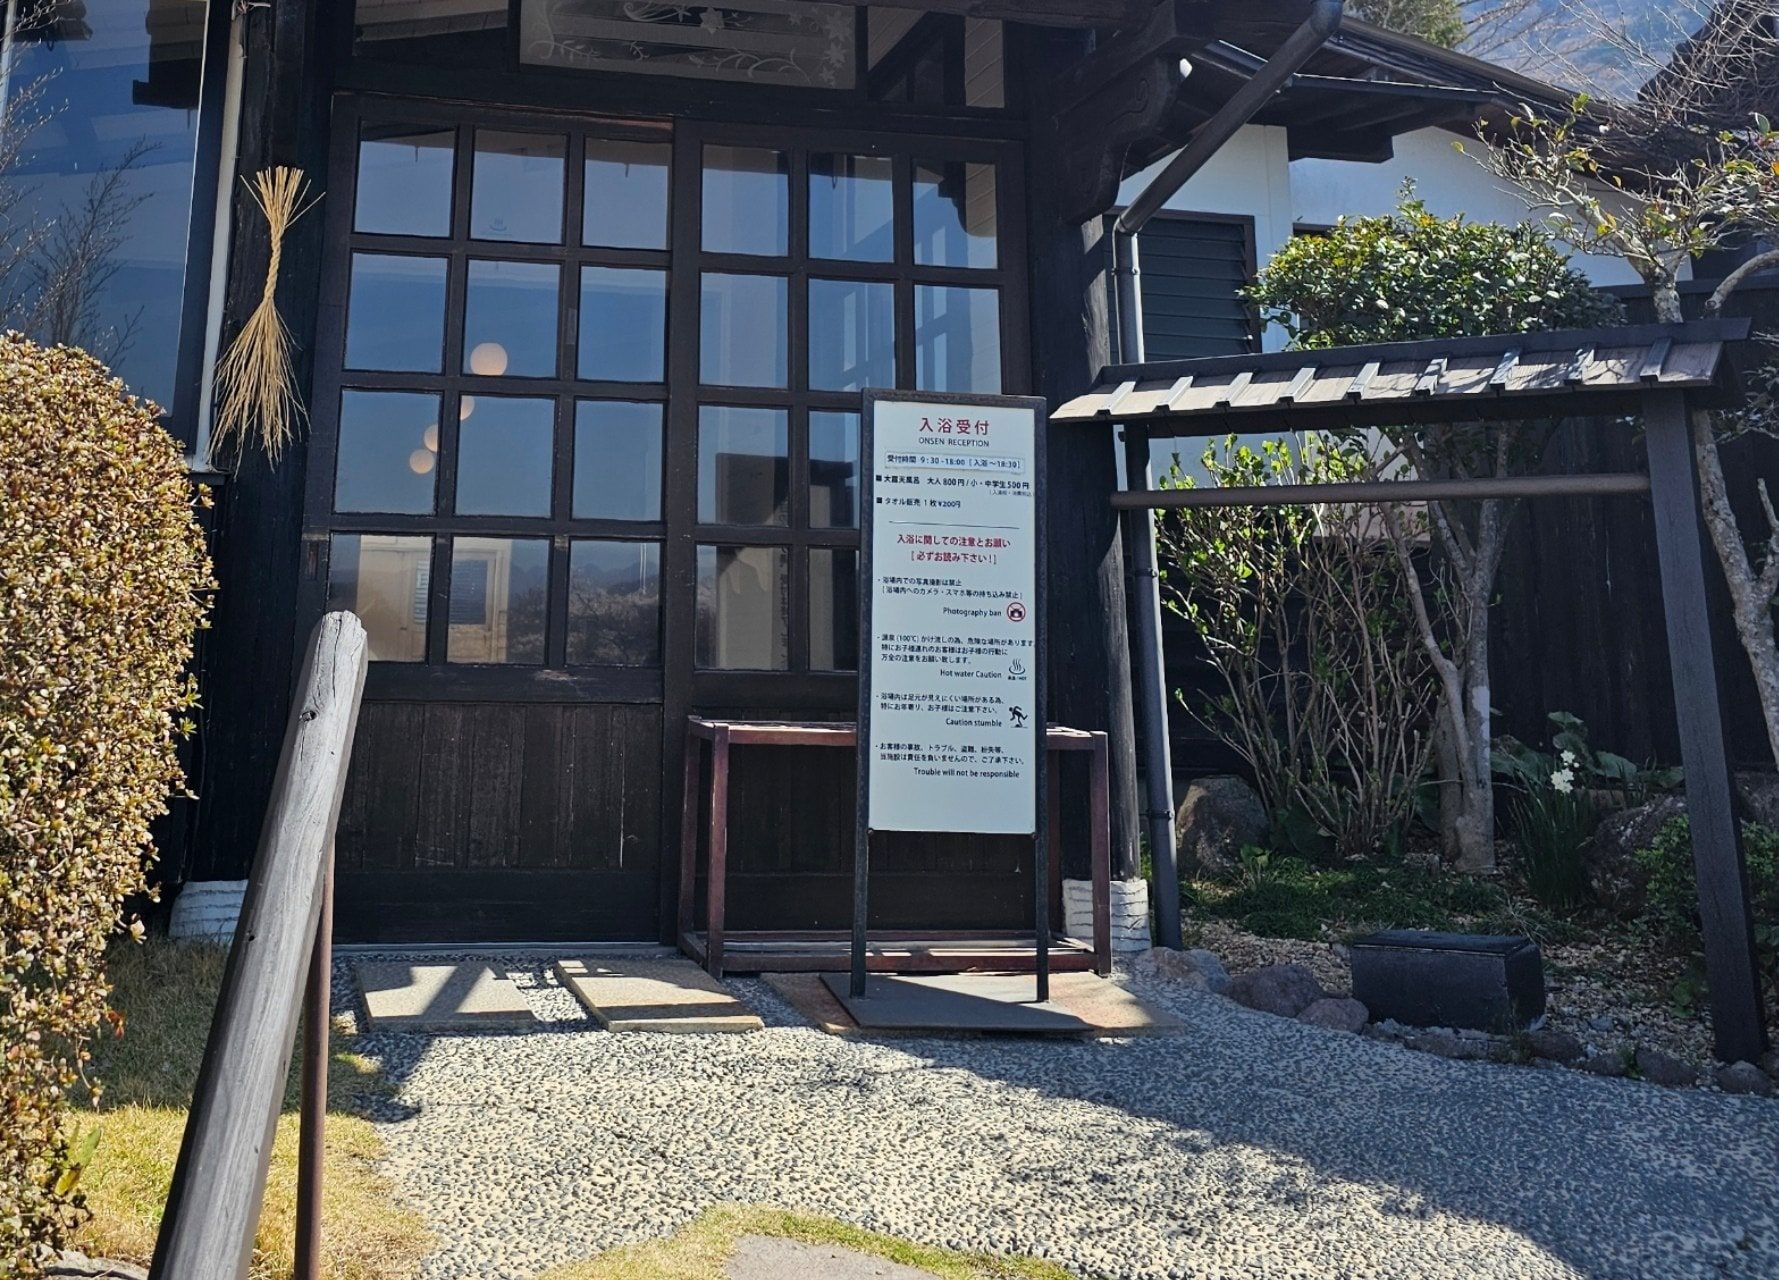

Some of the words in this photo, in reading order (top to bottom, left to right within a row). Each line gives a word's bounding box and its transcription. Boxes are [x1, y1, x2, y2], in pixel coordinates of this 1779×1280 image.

[919, 417, 990, 436] 入浴受付
[918, 437, 944, 446] ONSEN
[948, 438, 990, 448] RECEPTION
[887, 455, 917, 465] 受付時間
[883, 475, 920, 486] 大露天風呂
[884, 497, 921, 507] タオル販売
[897, 534, 1011, 549] 入浴に関しての注意とお願い
[943, 607, 989, 619] Photography
[989, 609, 1002, 617] ban
[940, 669, 953, 677] Hot
[954, 670, 974, 678] water
[975, 670, 1002, 679] Caution
[946, 718, 972, 726] Caution
[974, 719, 1002, 728] stumble
[914, 767, 941, 776] Trouble
[942, 768, 956, 776] will
[957, 769, 968, 777] not
[970, 769, 979, 777] be
[980, 770, 1019, 780] responsible
